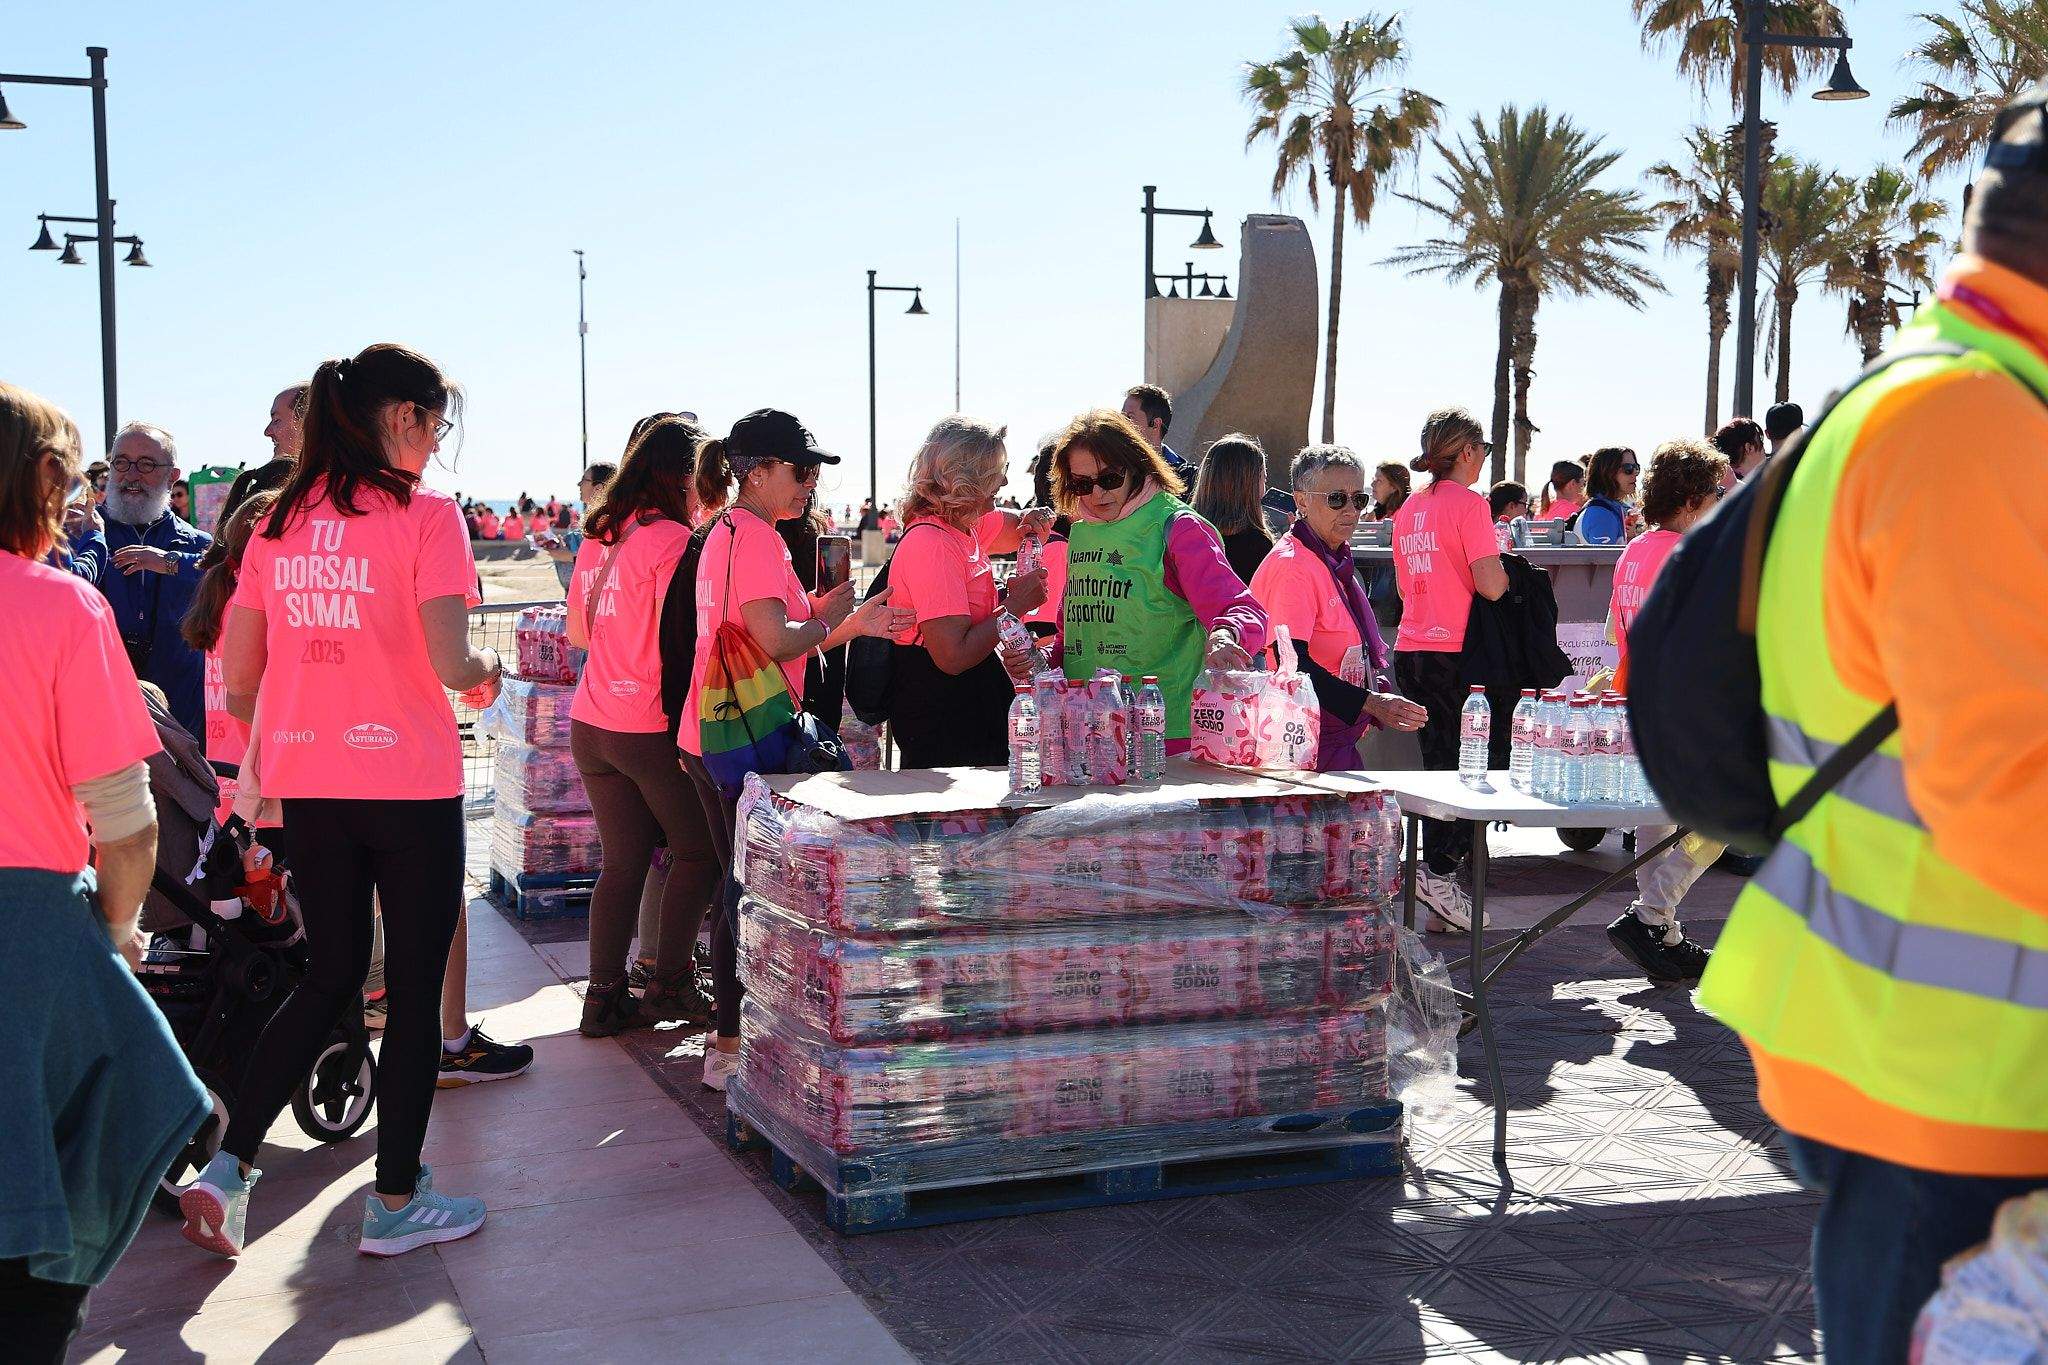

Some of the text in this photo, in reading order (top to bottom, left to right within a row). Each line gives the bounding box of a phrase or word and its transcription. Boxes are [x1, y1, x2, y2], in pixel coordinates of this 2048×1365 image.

[1414, 511, 1427, 531] TU
[311, 520, 346, 552] TU
[274, 555, 375, 594] DORSAL
[1625, 562, 1639, 582] TU
[286, 592, 361, 630] SUMA
[1066, 601, 1115, 626] Esportiu
[300, 639, 346, 665] 2025
[1558, 640, 1600, 648] EXCLUSIVO
[1194, 709, 1225, 720] ZERO
[208, 721, 225, 739] 25
[1195, 720, 1225, 732] SODIO
[348, 731, 394, 743] ASTURIANA
[1053, 970, 1101, 984] ZERO
[1172, 964, 1219, 977] ZERO
[1172, 976, 1220, 989] SODIO
